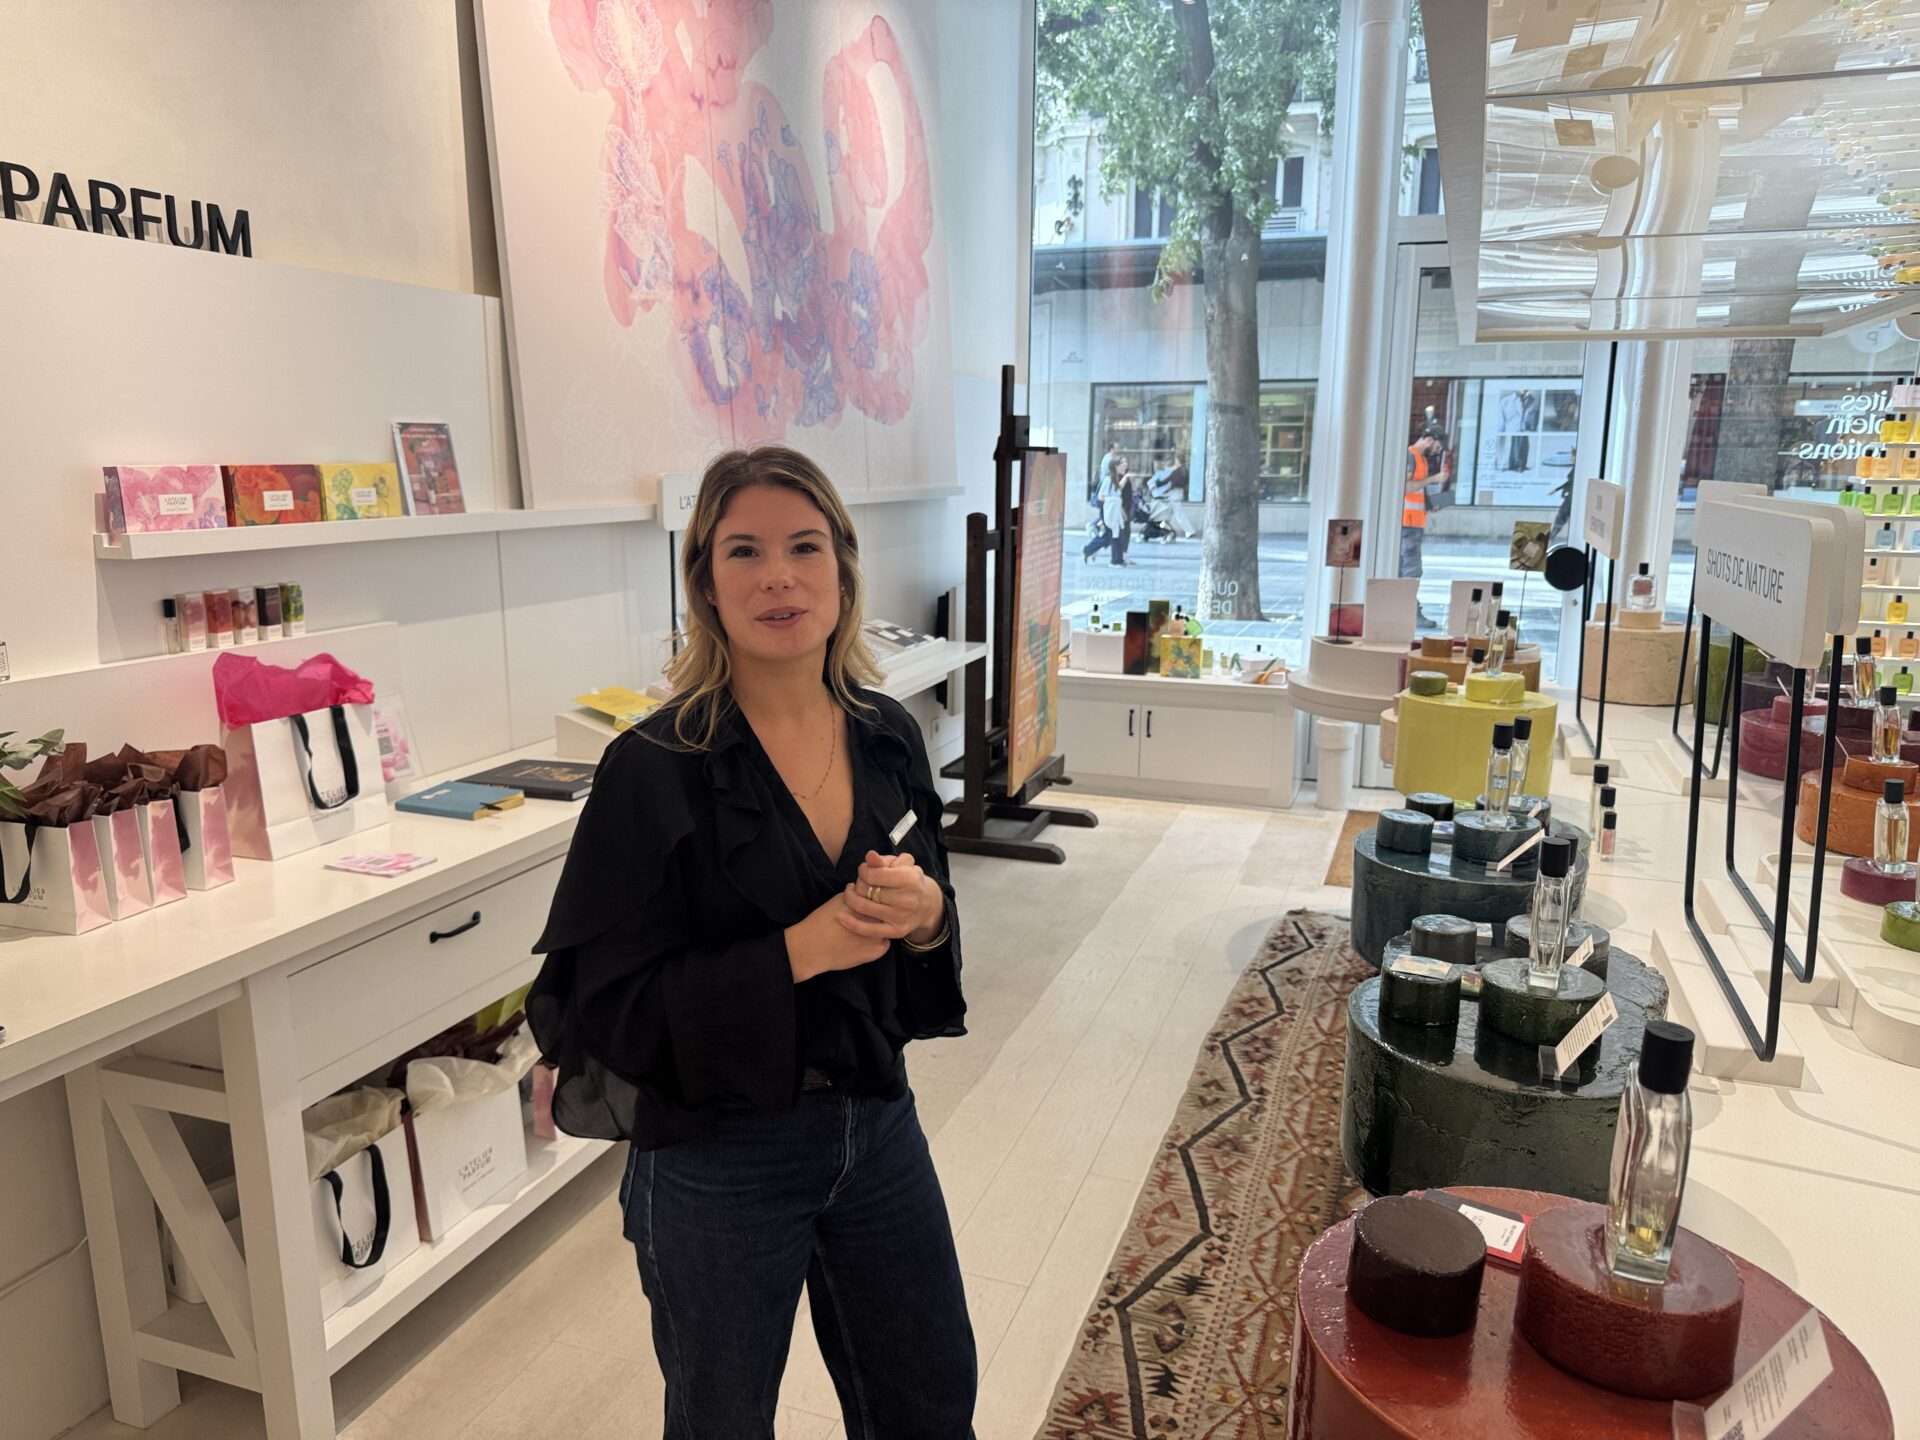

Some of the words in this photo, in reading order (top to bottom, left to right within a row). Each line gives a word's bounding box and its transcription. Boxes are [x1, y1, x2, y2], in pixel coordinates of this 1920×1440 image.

[0, 161, 252, 258] PARFUM
[1706, 547, 1732, 584] SHOTS
[1731, 556, 1745, 588] DE
[1744, 559, 1785, 605] NATURE
